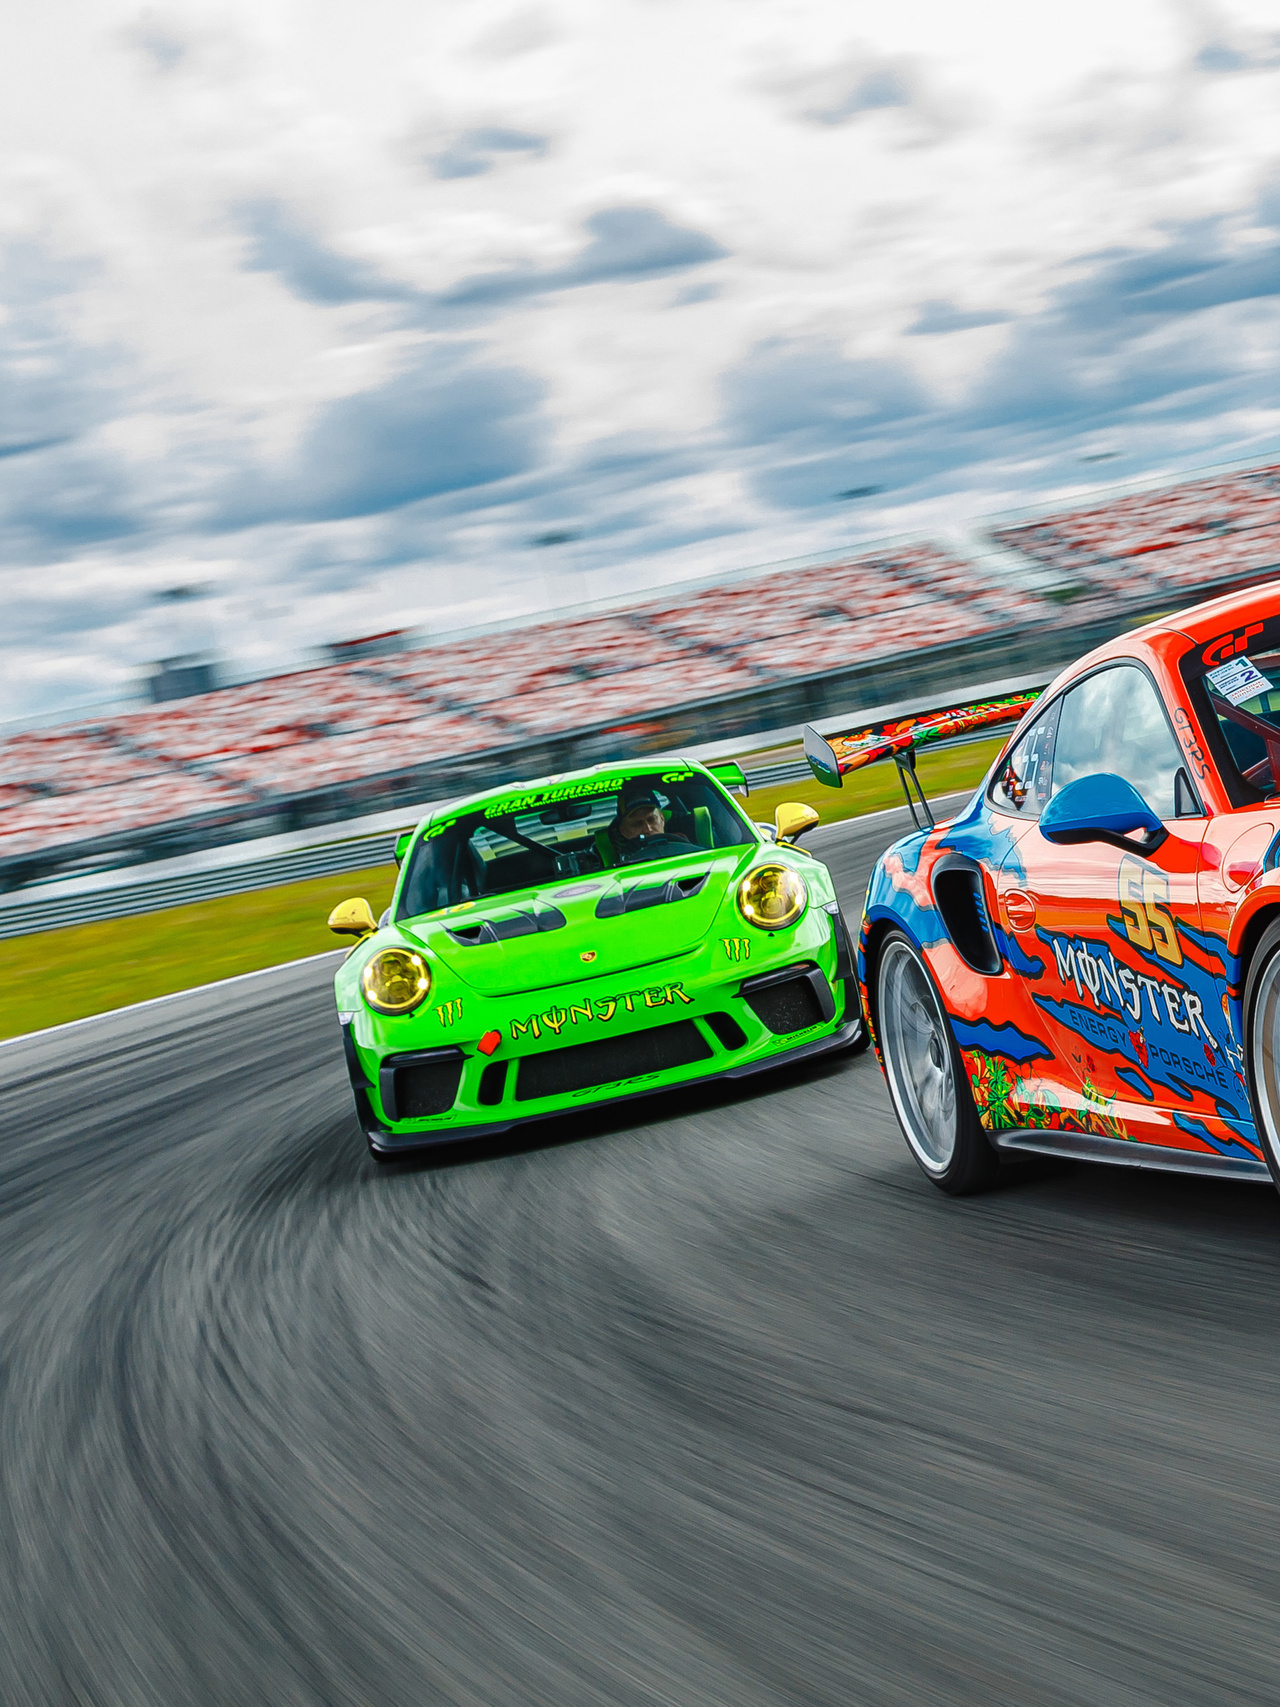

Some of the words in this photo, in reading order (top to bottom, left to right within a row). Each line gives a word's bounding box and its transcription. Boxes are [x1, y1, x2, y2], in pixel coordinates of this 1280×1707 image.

[1240, 670, 1258, 682] 2
[1174, 707, 1211, 780] GT3RS
[484, 795, 537, 816] GRAN
[541, 778, 624, 802] TURISMO
[1117, 853, 1183, 967] 55
[1069, 1009, 1127, 1048] ENERGY
[1148, 1043, 1229, 1090] PORSCHE
